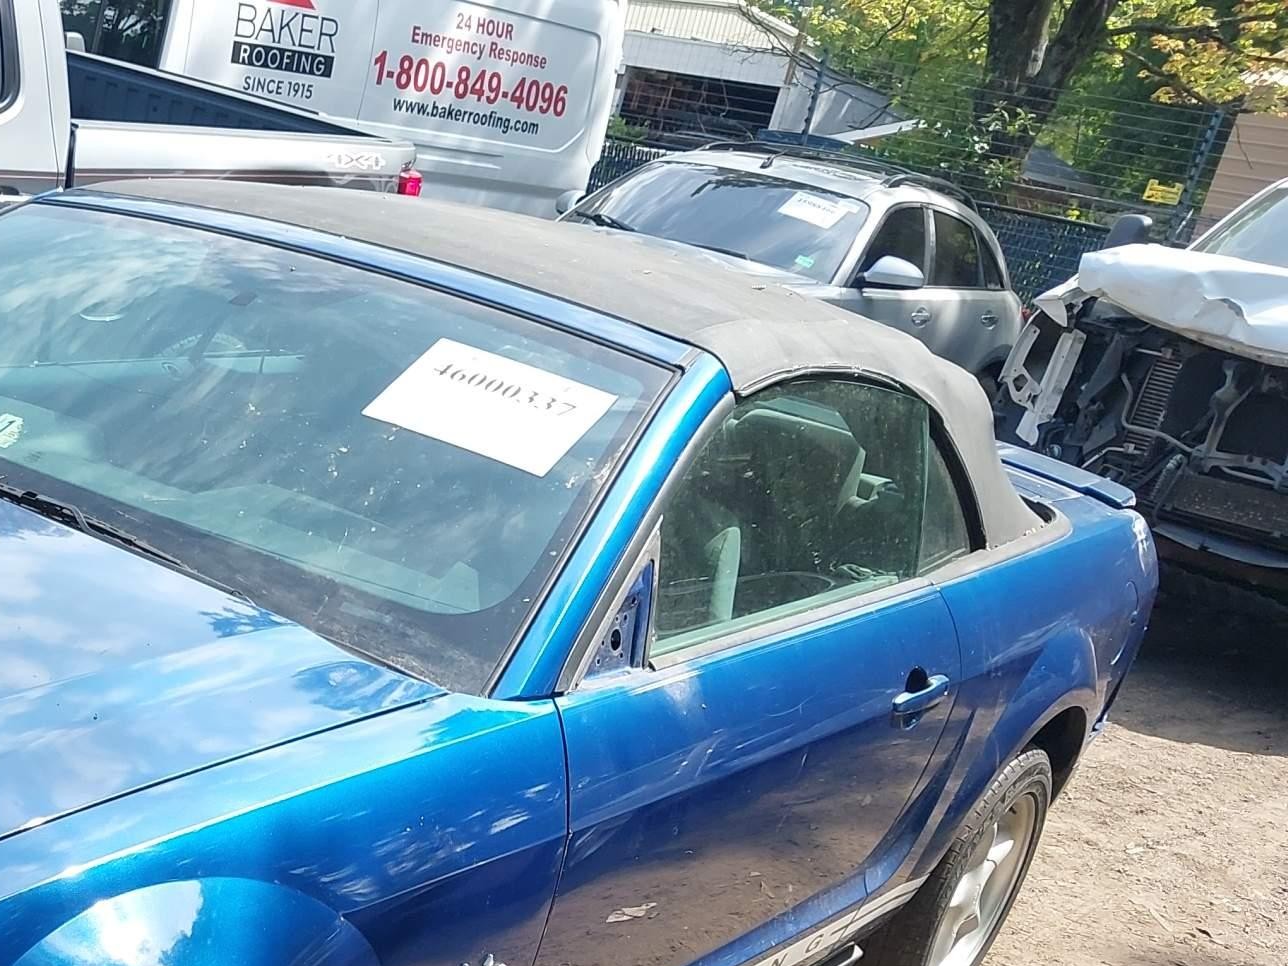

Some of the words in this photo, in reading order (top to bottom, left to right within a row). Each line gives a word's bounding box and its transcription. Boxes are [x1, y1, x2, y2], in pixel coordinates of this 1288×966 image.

[234, 2, 339, 53] BAKER
[456, 12, 473, 31] 24
[476, 17, 514, 41] HOUR
[239, 44, 326, 76] ROOFING
[411, 26, 486, 61] Emergency
[488, 41, 548, 69] Response
[242, 76, 284, 95] SINCE
[286, 81, 314, 99] 1915
[373, 50, 569, 118] 1-800-849-4096
[393, 97, 540, 135] www.bakerroofing.com
[432, 362, 578, 416] 46000337
